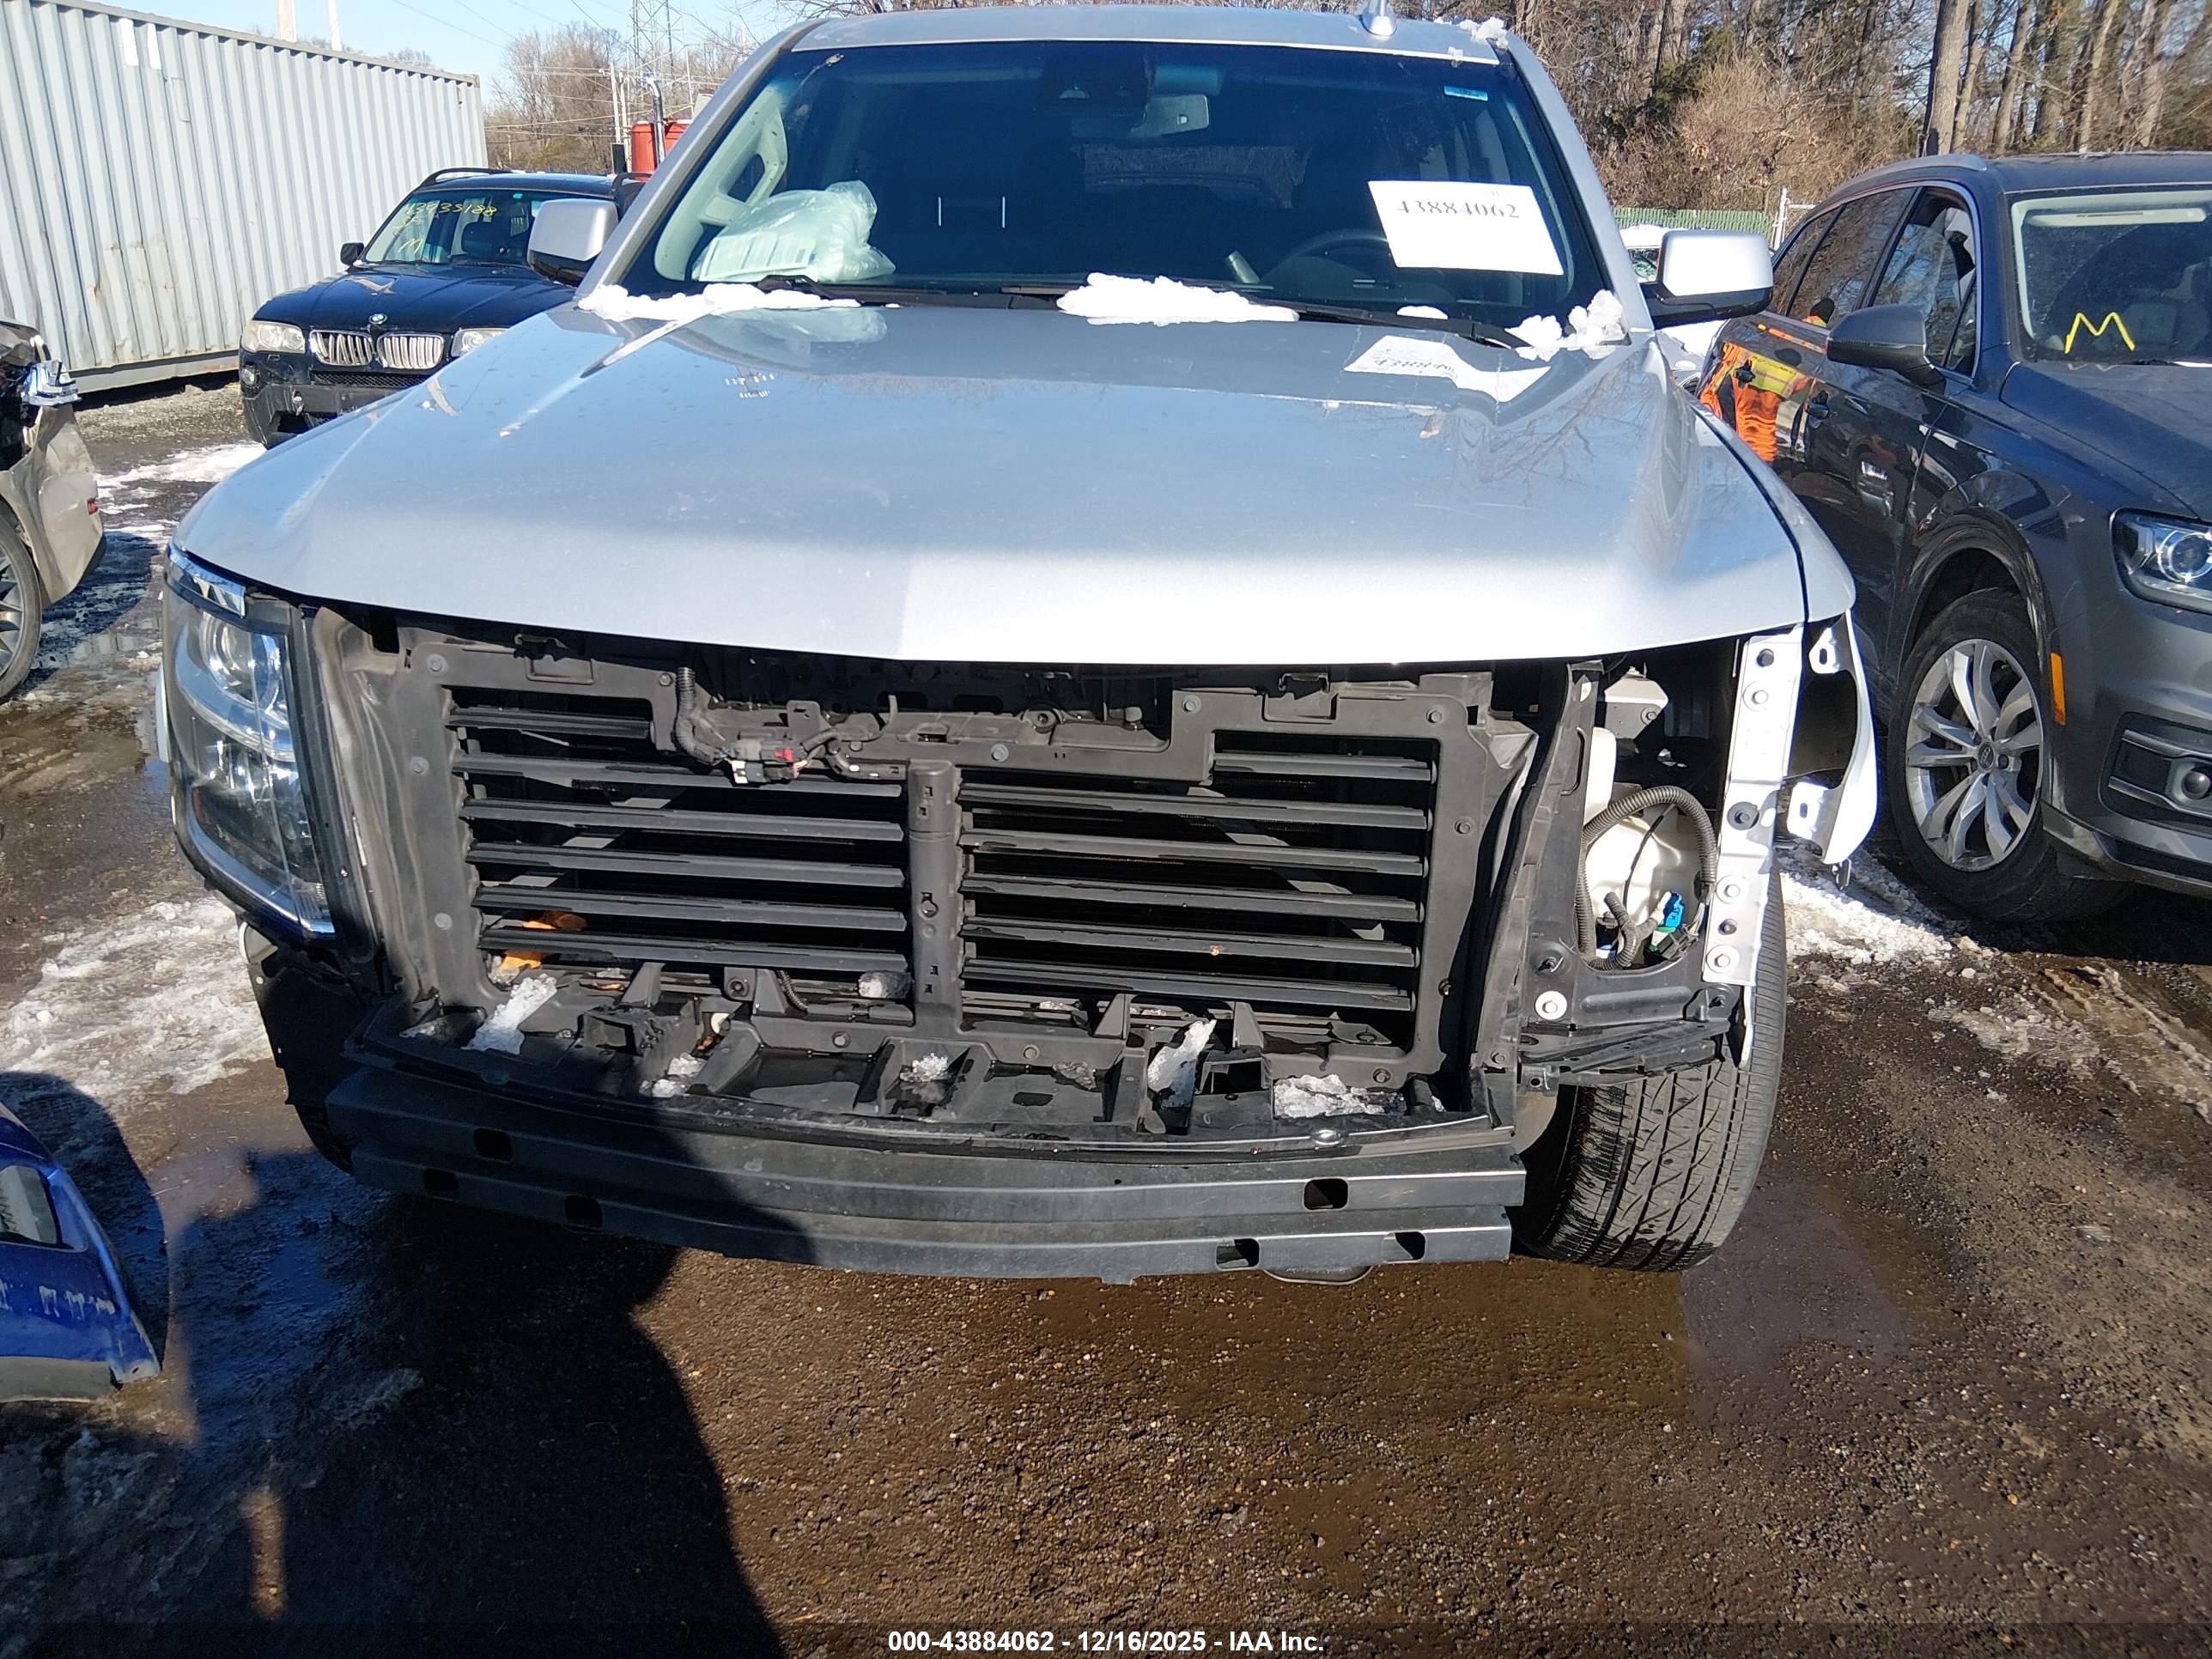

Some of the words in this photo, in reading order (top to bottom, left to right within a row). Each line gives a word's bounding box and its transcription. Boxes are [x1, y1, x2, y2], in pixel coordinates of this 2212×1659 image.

[1396, 200, 1521, 218] 43884062
[398, 237, 423, 254] M
[2064, 312, 2136, 354] M
